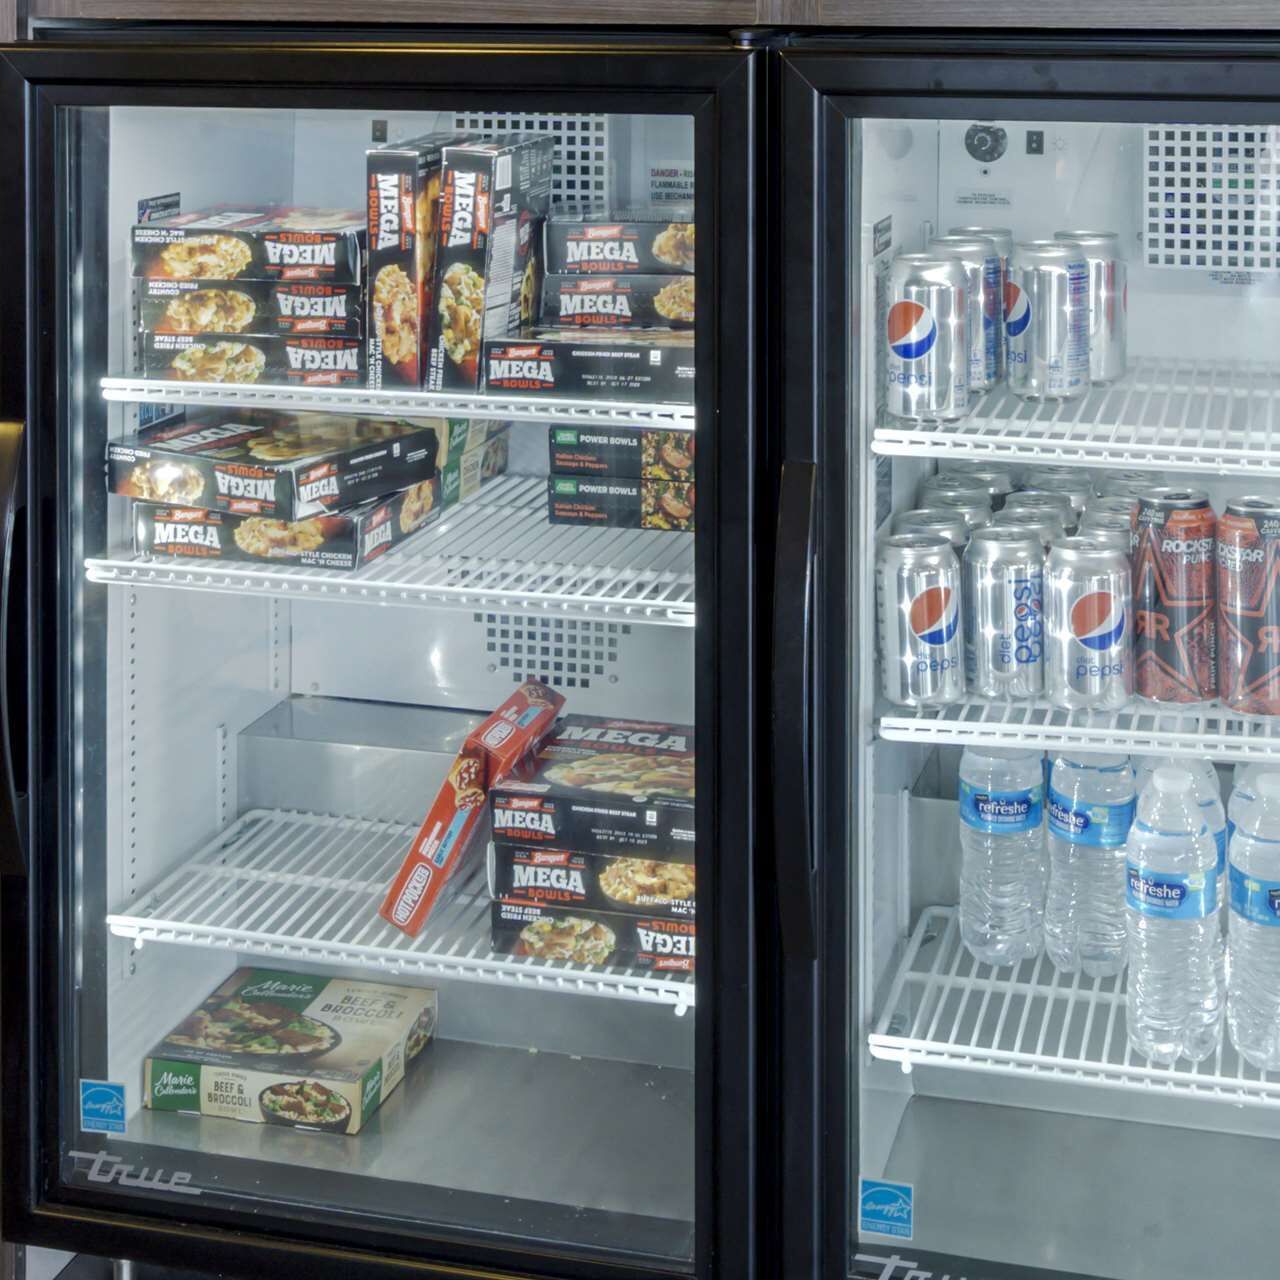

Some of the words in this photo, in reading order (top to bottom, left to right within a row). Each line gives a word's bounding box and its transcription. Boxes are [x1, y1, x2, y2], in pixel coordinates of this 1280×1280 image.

[368, 189, 378, 240] BOWLS
[377, 174, 400, 251] MEGA
[441, 186, 453, 236] BOWLS
[448, 171, 475, 248] MEGA
[278, 232, 322, 243] BOWLS
[264, 240, 337, 266] MEGA
[566, 241, 639, 263] MEGA
[581, 261, 624, 271] BOWLS
[290, 286, 333, 295] BOWLS
[276, 294, 348, 318] MEGA
[560, 294, 632, 317] MEGA
[575, 314, 618, 325] BOWLS
[175, 342, 206, 350] CHICKEN
[177, 335, 193, 343] BEEF
[300, 338, 344, 349] BOWLS
[286, 346, 359, 370] MEGA
[489, 359, 555, 382] MEGA
[503, 379, 541, 389] BOWLS
[580, 434, 609, 445] POWER
[609, 435, 638, 447] BOWLS
[226, 464, 264, 478] BOWLS
[214, 470, 277, 502] MEGA
[298, 475, 339, 504] MEGA
[579, 484, 608, 495] POWER
[608, 485, 637, 497] BOWLS
[154, 522, 221, 548] MEGA
[363, 520, 393, 556] MEGA
[166, 544, 209, 555] BOWLS
[320, 551, 353, 562] CHICKEN
[300, 556, 317, 565] MAC
[325, 558, 353, 567] CHEESE
[1008, 578, 1033, 664] pepsi
[998, 635, 1012, 664] diet
[556, 725, 688, 753] MEGA
[978, 799, 1029, 815] refreshe
[494, 808, 556, 835] MEGA
[506, 829, 544, 840] BOWLS
[512, 864, 586, 895] MEGA
[1130, 876, 1182, 899] refreshe
[527, 888, 571, 901] BOWLS
[671, 906, 688, 914] MAC
[259, 979, 313, 994] Marie
[339, 995, 381, 1007] BEEF
[320, 1003, 405, 1019] BROCCOLI
[160, 1071, 194, 1086] Marie
[213, 1080, 235, 1093] BEEF
[237, 1084, 244, 1094] &
[207, 1091, 252, 1108] BROCCOLI
